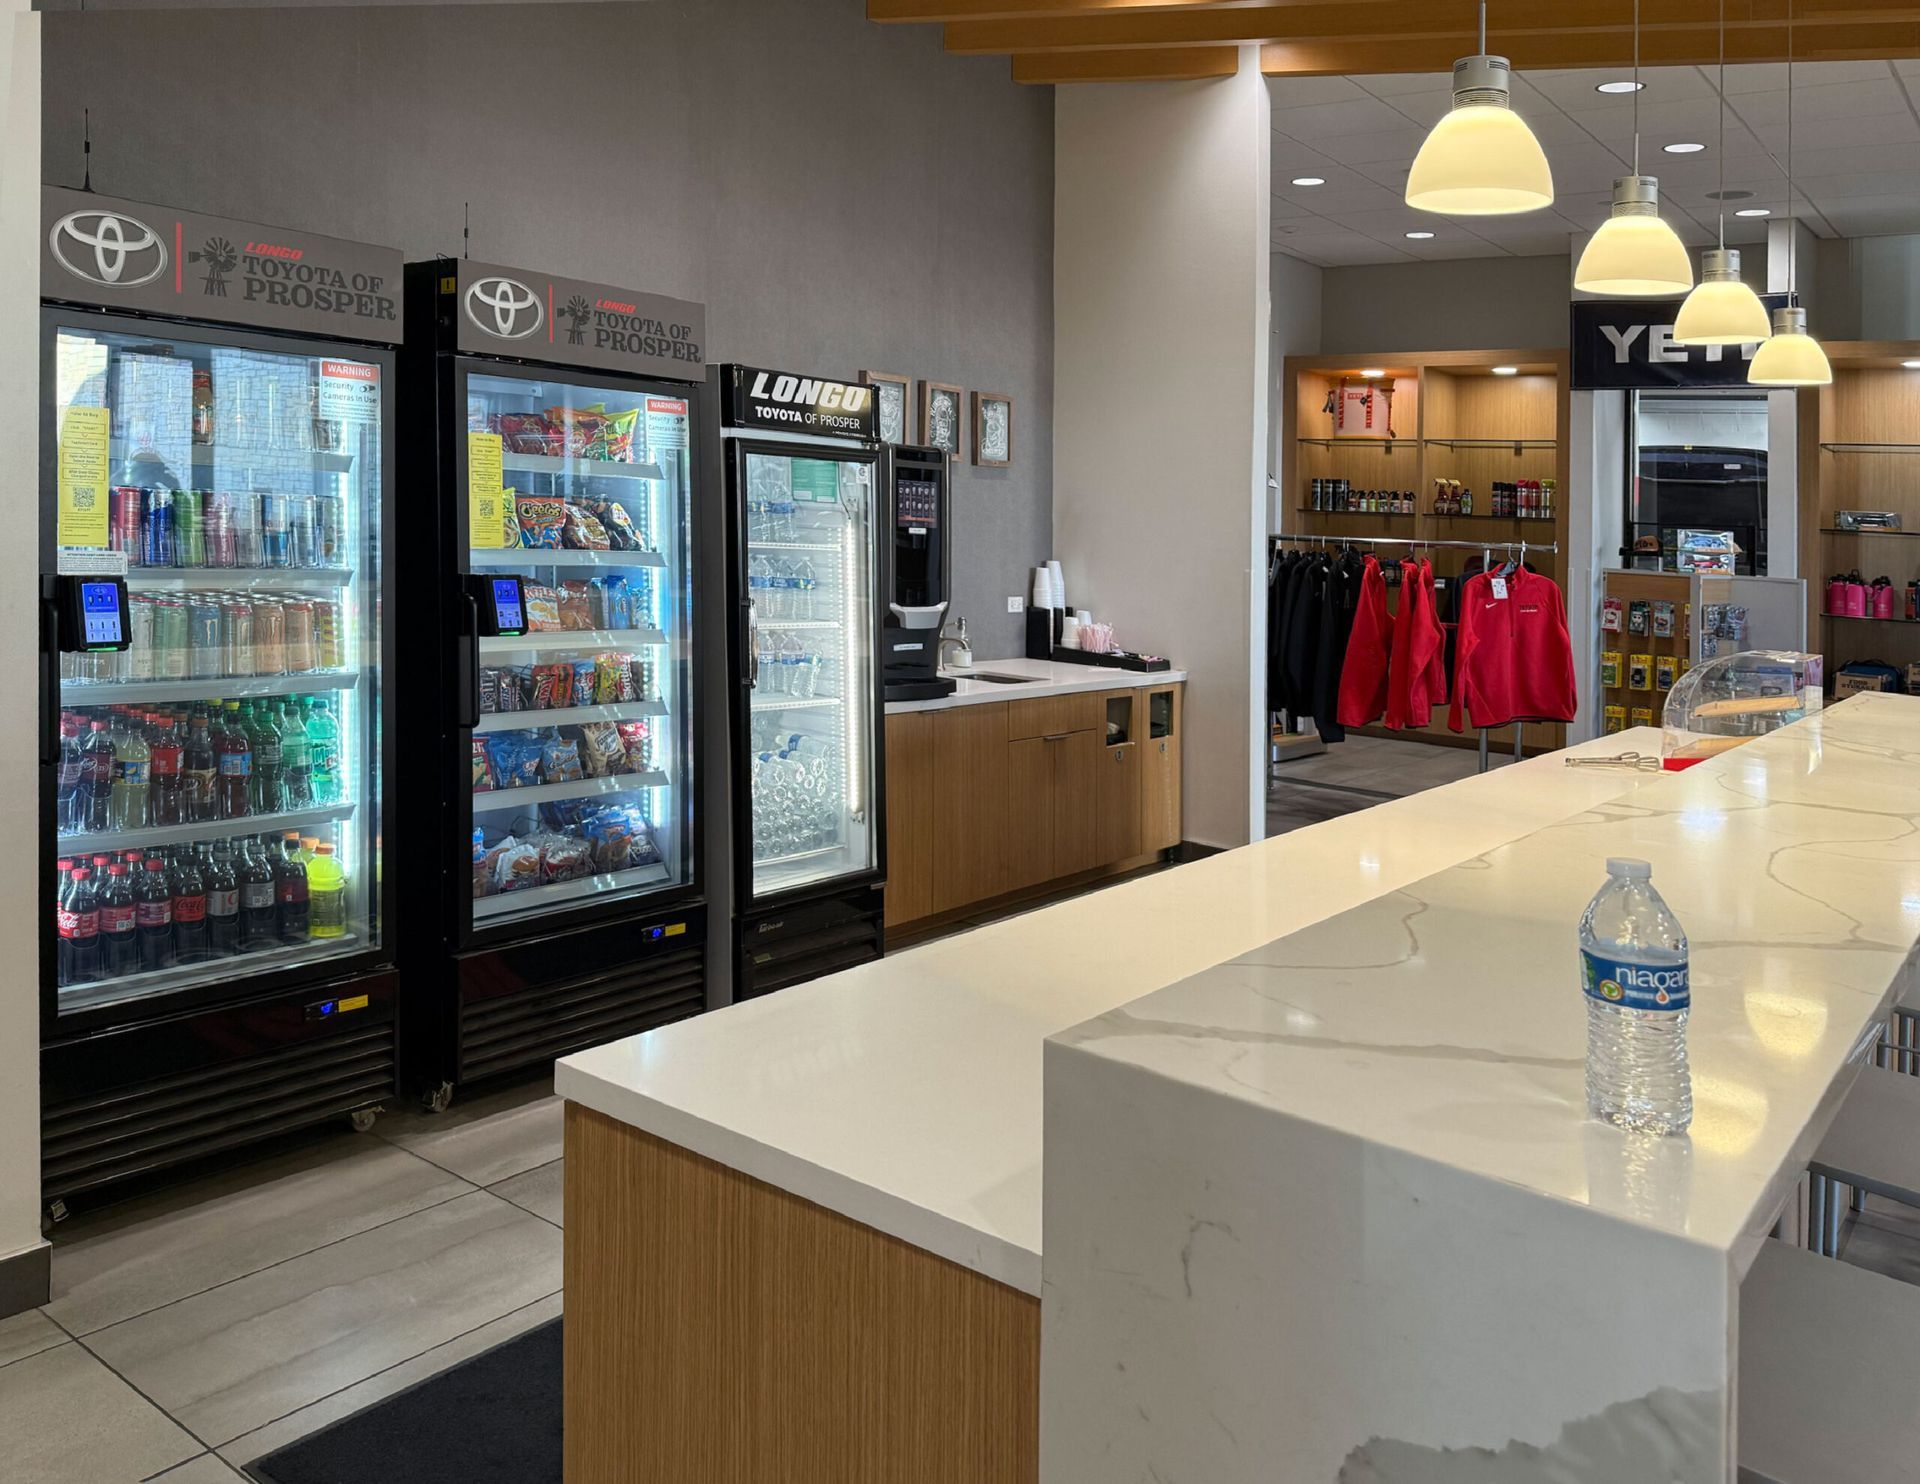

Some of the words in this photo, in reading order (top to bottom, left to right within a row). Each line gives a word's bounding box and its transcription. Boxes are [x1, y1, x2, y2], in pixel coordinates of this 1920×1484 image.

[243, 241, 304, 261] LONGO
[242, 254, 348, 289] TOYOTA
[351, 273, 384, 294] OF
[243, 277, 397, 321] PROSPER
[595, 298, 637, 314] LONGO
[594, 310, 666, 337] TOYOTA
[669, 323, 692, 341] OF
[594, 328, 701, 364] PROSPER
[327, 364, 372, 377] WARNING
[323, 381, 355, 391] Security
[750, 371, 866, 412] LONGO
[322, 391, 355, 402] Cameras
[363, 396, 378, 404] Use
[650, 401, 683, 411] WARNING
[755, 405, 803, 423] TOYOTA
[804, 412, 818, 425] OF
[820, 413, 861, 429] PROSPER
